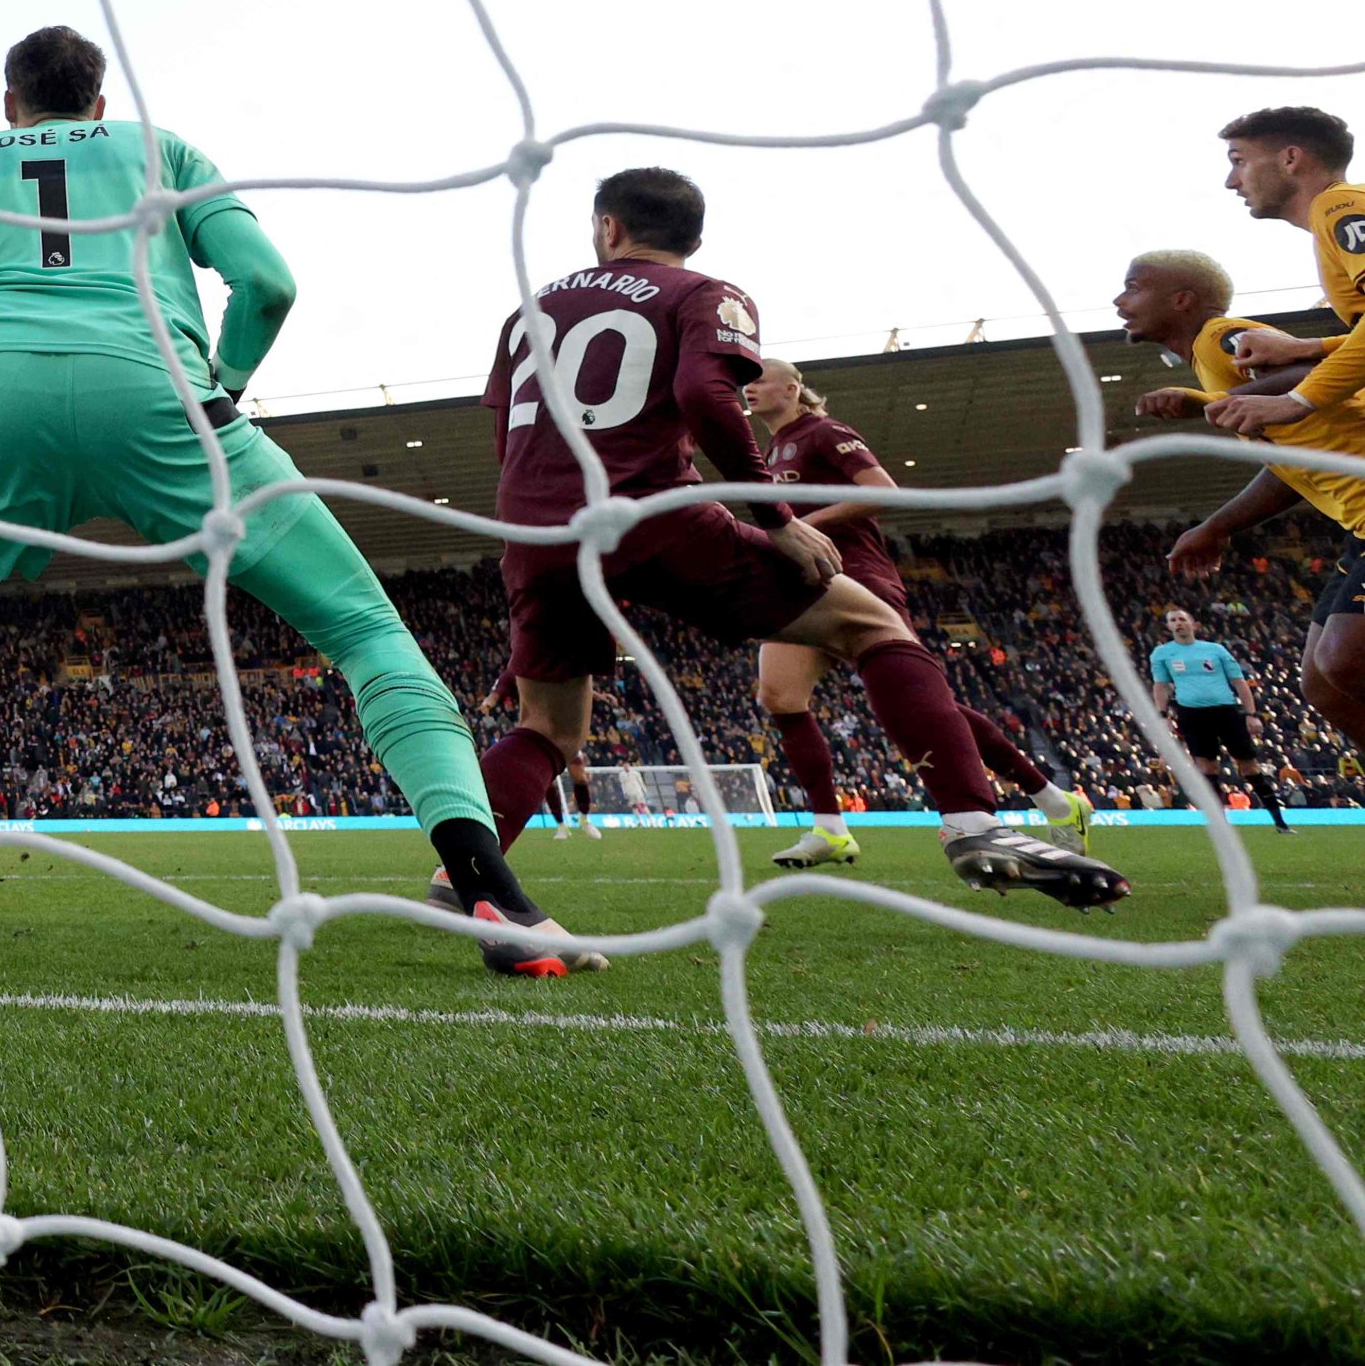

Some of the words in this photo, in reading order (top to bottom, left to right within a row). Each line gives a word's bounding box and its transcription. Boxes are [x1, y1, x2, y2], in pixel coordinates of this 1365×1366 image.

[68, 123, 110, 144] SÁ
[20, 158, 73, 269] 1
[535, 271, 661, 304] ERNARDO
[508, 308, 658, 431] 20
[272, 819, 338, 830] ARCLAYS
